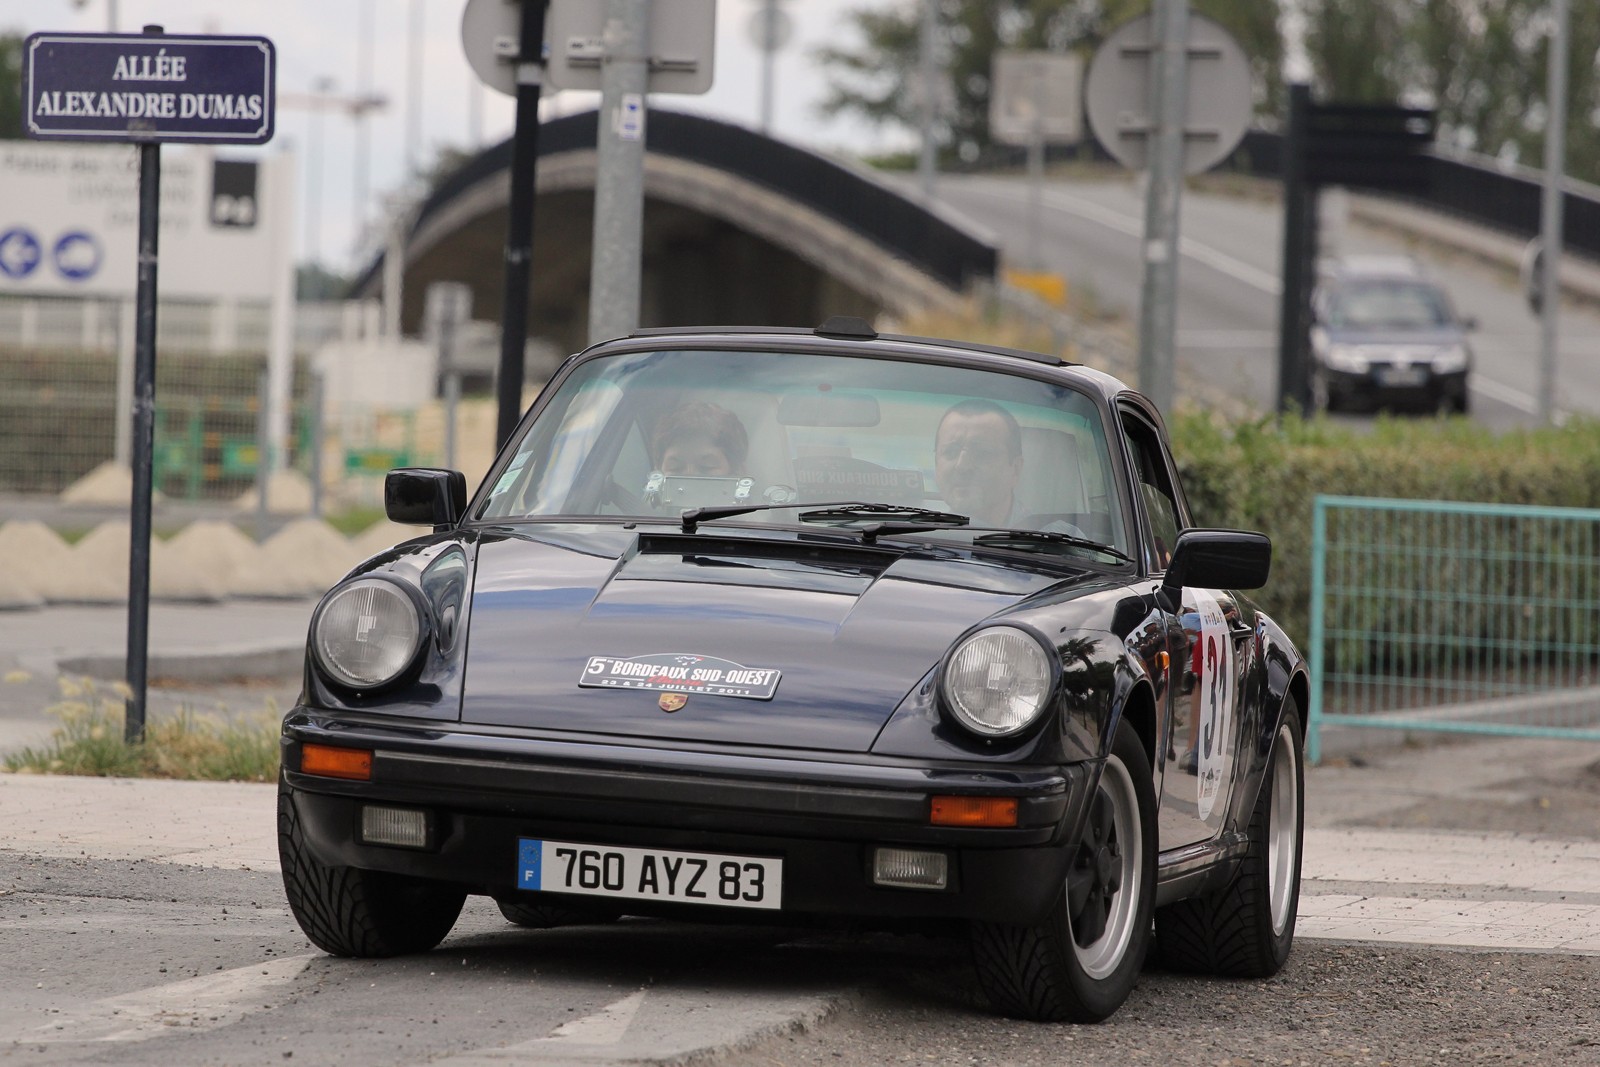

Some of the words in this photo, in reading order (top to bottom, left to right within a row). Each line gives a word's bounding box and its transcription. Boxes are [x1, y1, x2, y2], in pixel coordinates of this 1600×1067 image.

[112, 48, 187, 82] ALLÉE
[36, 91, 176, 119] ALEXANDRE
[179, 93, 262, 120] DUMAS
[610, 660, 691, 680] BORDEAUX
[690, 668, 775, 686] SUD-OUEST
[658, 682, 713, 693] JUILLET
[1203, 634, 1227, 760] 31
[524, 870, 534, 882] F
[556, 847, 625, 891] 760
[638, 854, 708, 898] AYZ
[718, 861, 765, 902] 83
